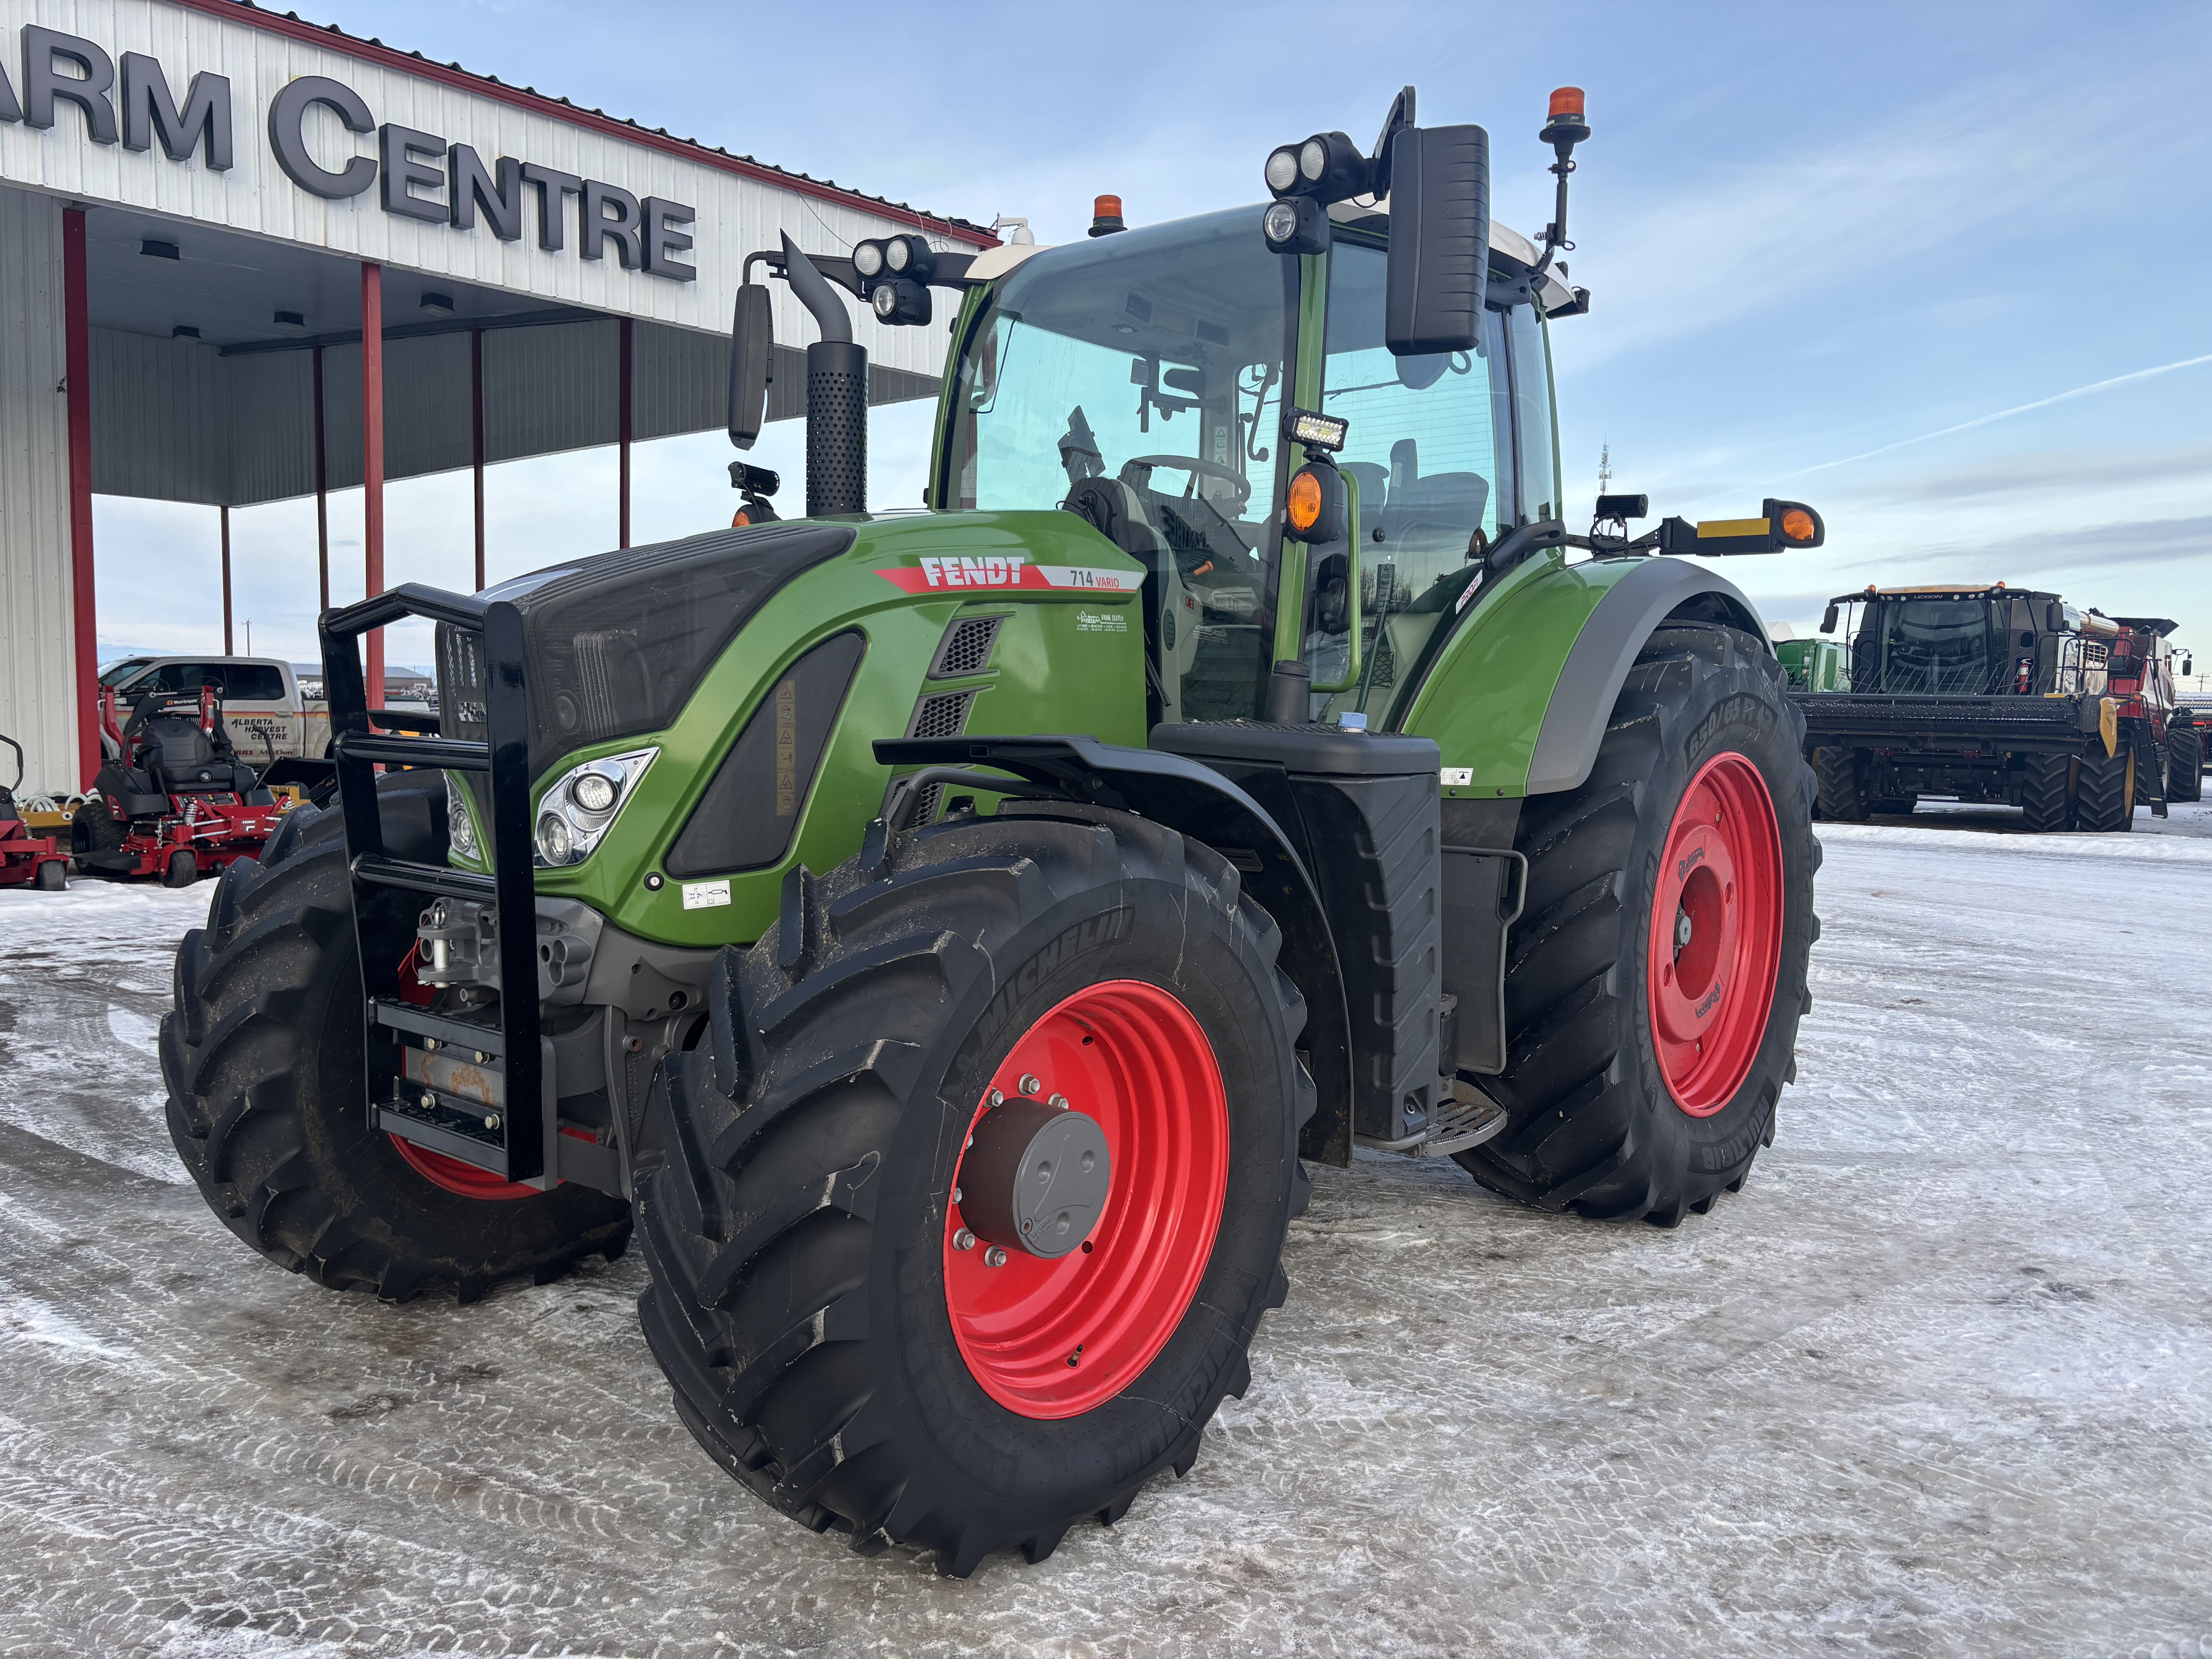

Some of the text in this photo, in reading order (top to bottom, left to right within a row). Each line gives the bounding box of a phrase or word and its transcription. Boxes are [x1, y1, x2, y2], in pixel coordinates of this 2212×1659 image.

[269, 76, 697, 282] CENTRE
[919, 556, 1025, 586] FENDT
[1070, 570, 1119, 588] 714 VARIO
[232, 719, 273, 728] ALBERTA
[1688, 699, 1740, 762] 650/65
[973, 910, 1132, 1049] MICHELIN
[1635, 854, 1657, 1069] MICHELIN
[1700, 1091, 1769, 1171] MULTIBIB
[1113, 1320, 1239, 1481] MICHELIN
